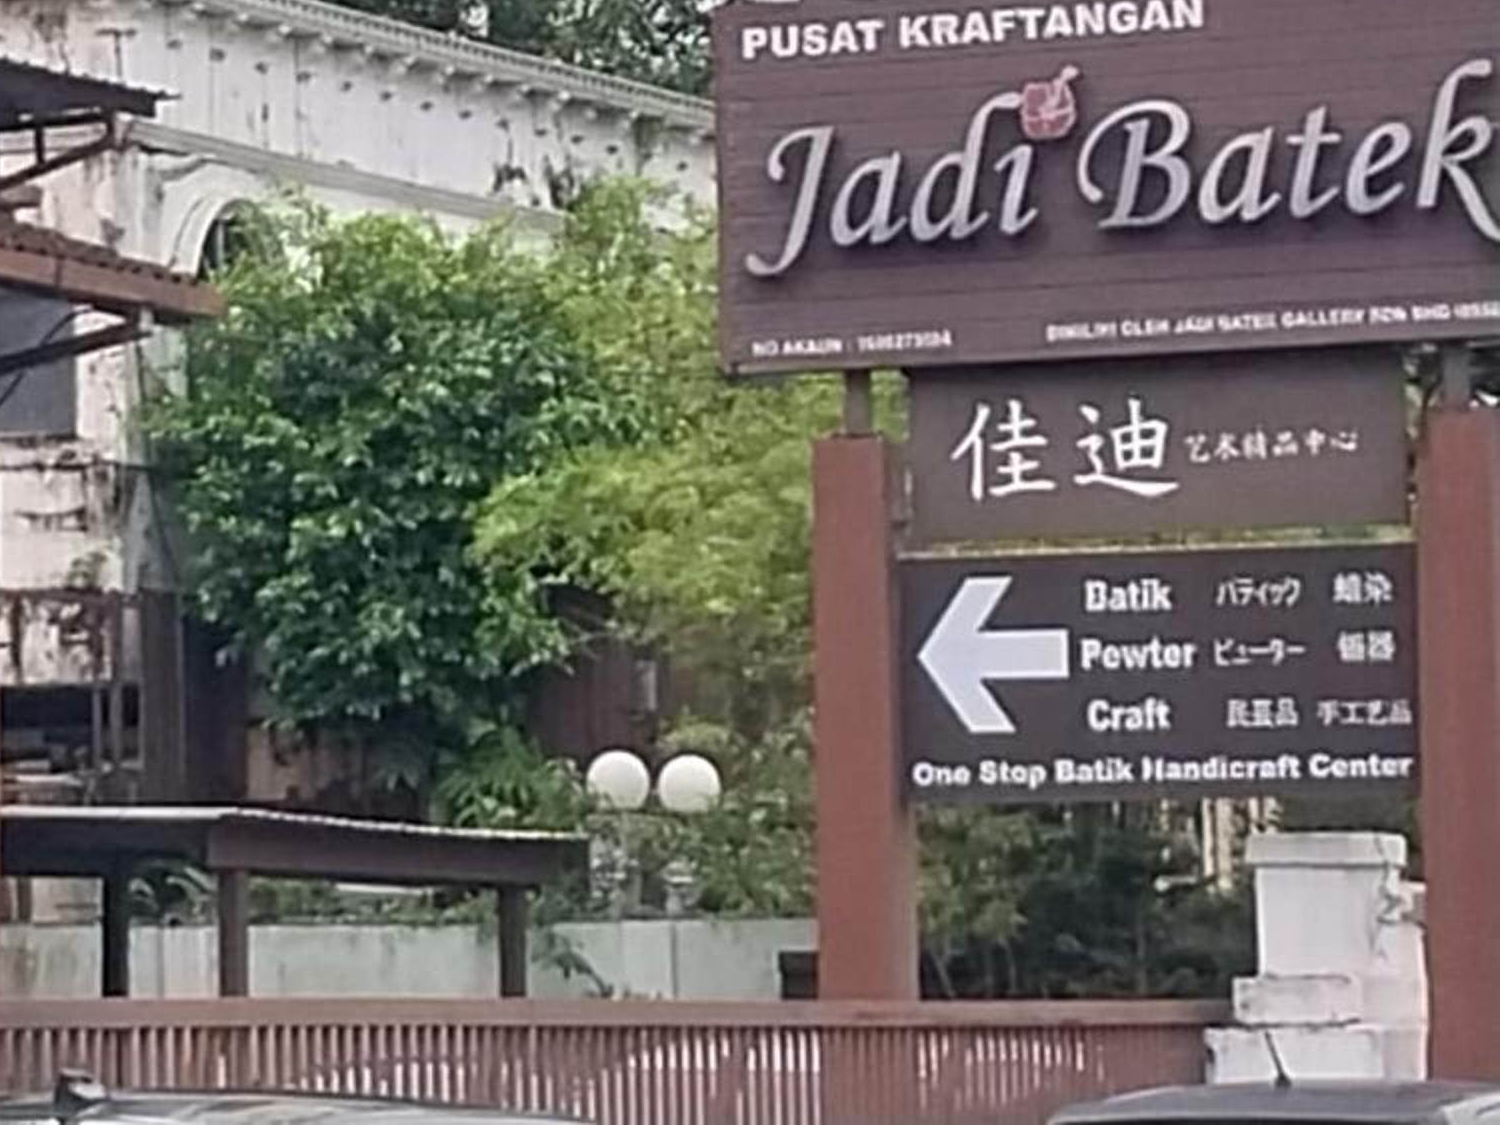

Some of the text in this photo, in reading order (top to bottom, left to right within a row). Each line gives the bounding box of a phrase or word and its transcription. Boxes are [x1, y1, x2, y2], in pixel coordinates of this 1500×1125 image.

[741, 19, 884, 59] PUSAT
[745, 59, 1500, 278] Jadi Batek
[950, 397, 1180, 501] 佳迪
[1084, 579, 1172, 611] Batik
[1080, 638, 1198, 670] Pewter
[1086, 699, 1172, 731] Craft
[912, 752, 1414, 789] One Stop Batik Handicraft Center
